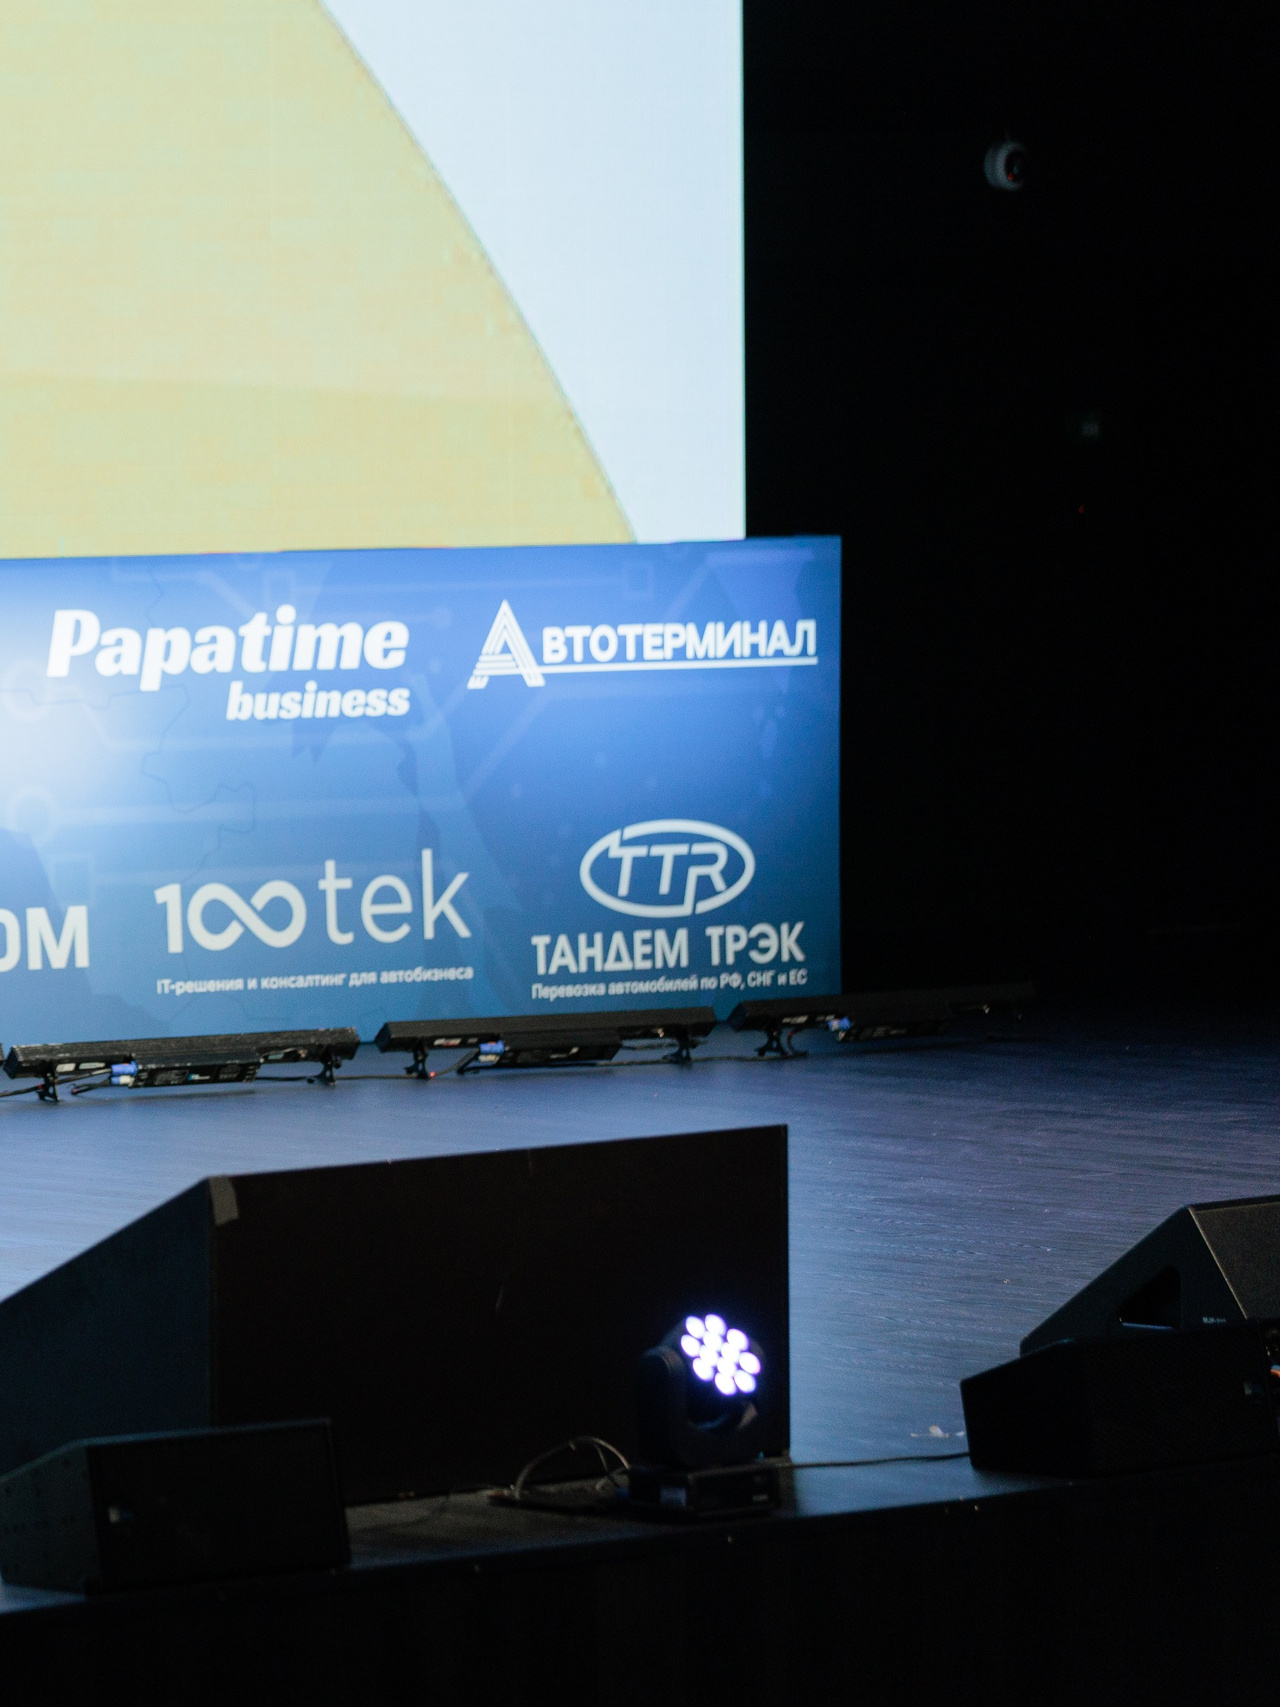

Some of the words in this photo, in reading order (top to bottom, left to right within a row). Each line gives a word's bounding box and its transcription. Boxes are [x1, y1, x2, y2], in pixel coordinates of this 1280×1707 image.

[47, 605, 410, 692] Papatime
[226, 681, 410, 721] business
[531, 928, 689, 976] ТАНДЕМ
[705, 921, 806, 967] ТРЭК
[157, 978, 244, 996] IT-решения
[247, 978, 257, 990] и
[261, 973, 346, 990] консалтинг
[349, 971, 377, 987] для
[380, 966, 475, 984] автобизнеса
[532, 981, 606, 1002] Перевозка
[608, 974, 698, 996] автомобилей
[700, 976, 718, 991] по
[747, 970, 775, 987] СНГ
[777, 972, 787, 986] и
[789, 969, 808, 986] ЕС
